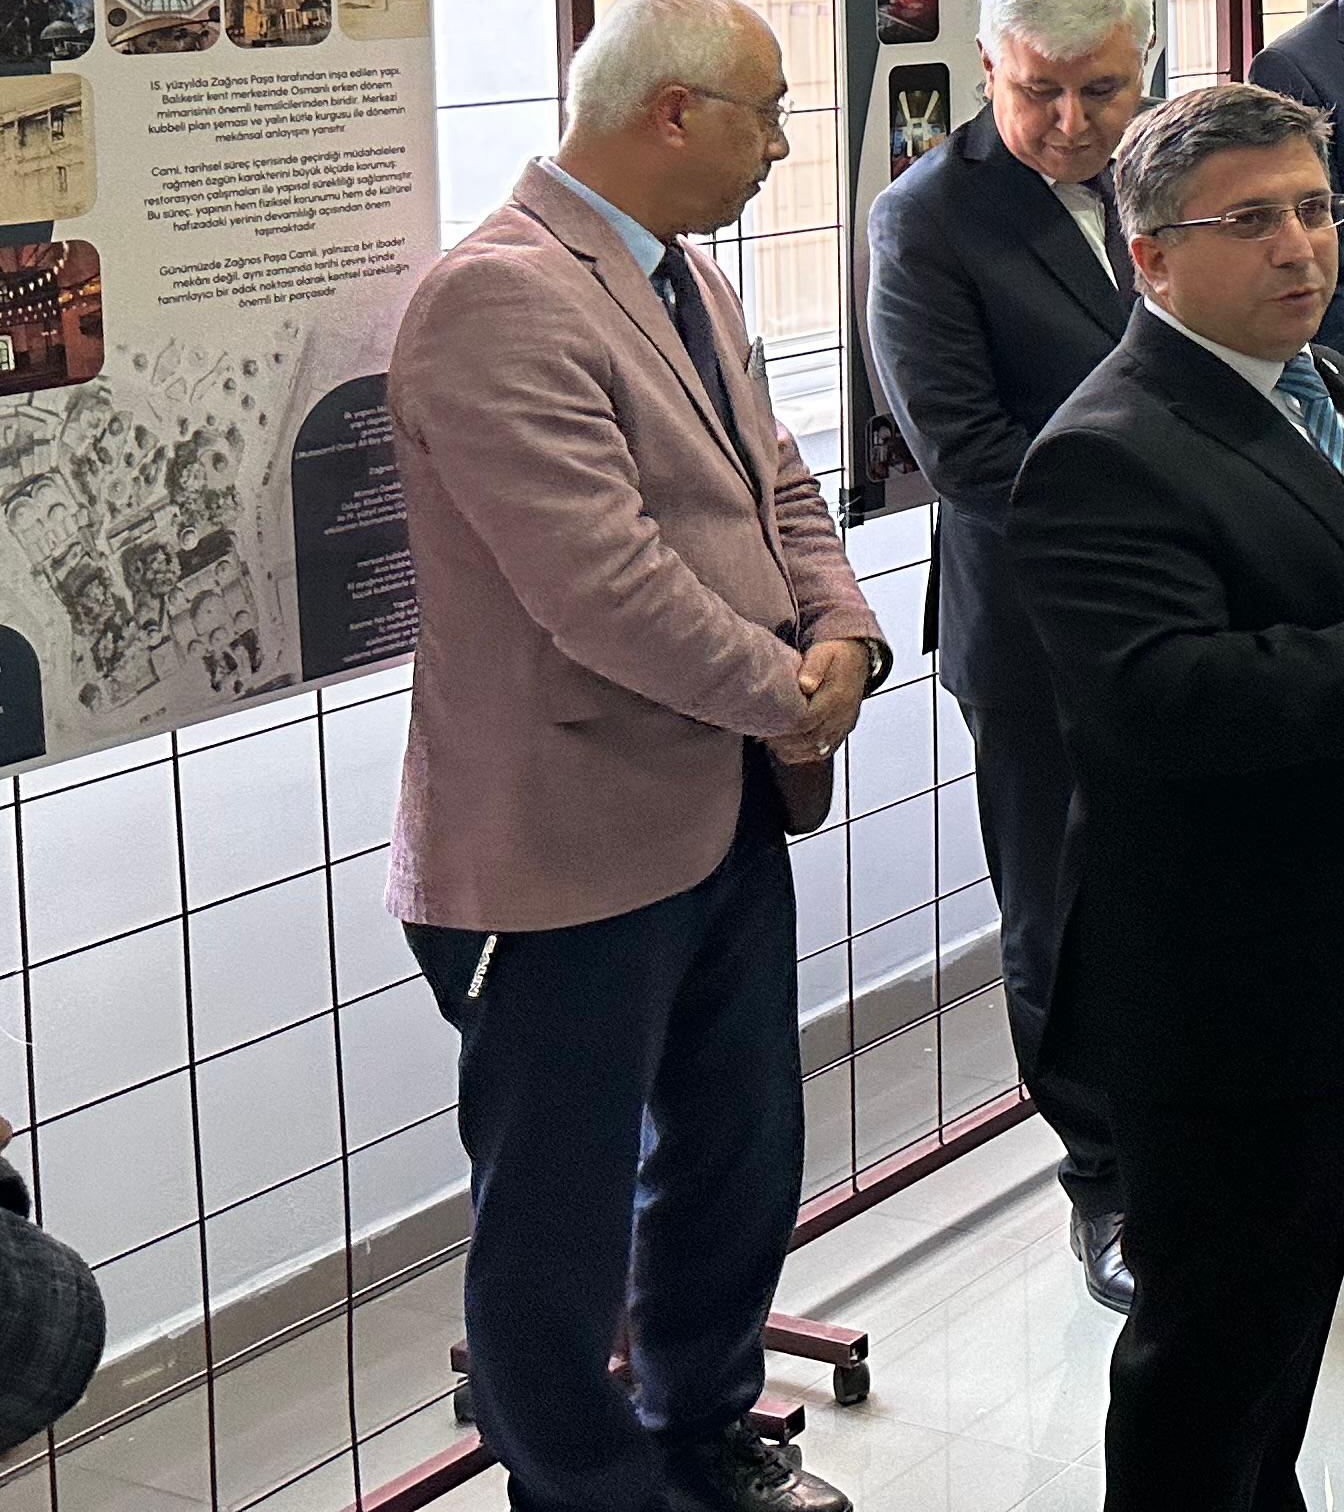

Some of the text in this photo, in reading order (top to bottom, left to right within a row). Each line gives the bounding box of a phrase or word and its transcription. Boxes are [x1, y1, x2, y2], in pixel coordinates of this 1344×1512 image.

[162, 80, 393, 105] Balıkesir kent merkezinde Osmanlı erken dönem
[165, 77, 209, 92] yüzyılda
[211, 76, 249, 88] Zağnos
[250, 74, 275, 86] Paşa
[276, 70, 327, 83] tarafından
[328, 68, 348, 80] inşa
[349, 67, 378, 78] edilen
[148, 105, 406, 134] kubbeli plan şeması ve yalın kütle kurgusu ile dönemin
[156, 106, 216, 119] mimarisinin
[217, 102, 252, 114] önemli
[253, 98, 329, 113] temsilcilerinden
[361, 91, 398, 103] Merkezi
[215, 129, 263, 143] mekânsal
[184, 160, 222, 174] tarihsel
[223, 160, 250, 171] süreç
[252, 155, 298, 168] içerisinde
[300, 150, 341, 165] geçirdiği
[343, 145, 406, 158] müdahalelere
[162, 178, 204, 192] rağmen
[205, 175, 237, 187] özgün
[238, 168, 290, 183] karakterini
[292, 165, 322, 179] büyük
[323, 162, 355, 175] ölçüde
[143, 191, 205, 206] restorasyon
[206, 187, 261, 202] çalışmaları
[262, 184, 275, 194] ile
[276, 180, 311, 194] yapısal
[147, 210, 161, 221] Bu
[195, 203, 233, 218] yapının
[234, 201, 257, 210] hem
[258, 196, 292, 209] fiziksel
[293, 191, 341, 205] korunumu
[342, 189, 364, 199] hem
[365, 187, 378, 197] de
[379, 183, 413, 195] kültürel
[172, 218, 228, 232] hafızadaki
[229, 213, 263, 227] yerinin
[318, 202, 364, 216] açısından
[364, 199, 392, 210] önem
[159, 260, 222, 276] Günümüzde
[224, 255, 262, 269] Zağnos
[263, 252, 287, 264] Paşa
[321, 242, 360, 258] yalnızca
[361, 240, 374, 250] bir
[376, 236, 406, 249] ibadet
[173, 276, 211, 288] mekânı
[242, 269, 264, 281] aynı
[265, 262, 313, 277] zamanda
[314, 257, 339, 269] tarihi
[340, 256, 366, 268] çevre
[368, 250, 395, 264] içinde
[157, 290, 214, 305] tanımlayıcı
[215, 287, 230, 298] bir
[231, 283, 257, 295] odak
[259, 279, 294, 292] noktası
[296, 275, 326, 287] olarak
[327, 269, 361, 282] kentsel
[238, 294, 272, 308] önemli
[273, 292, 287, 303] bir
